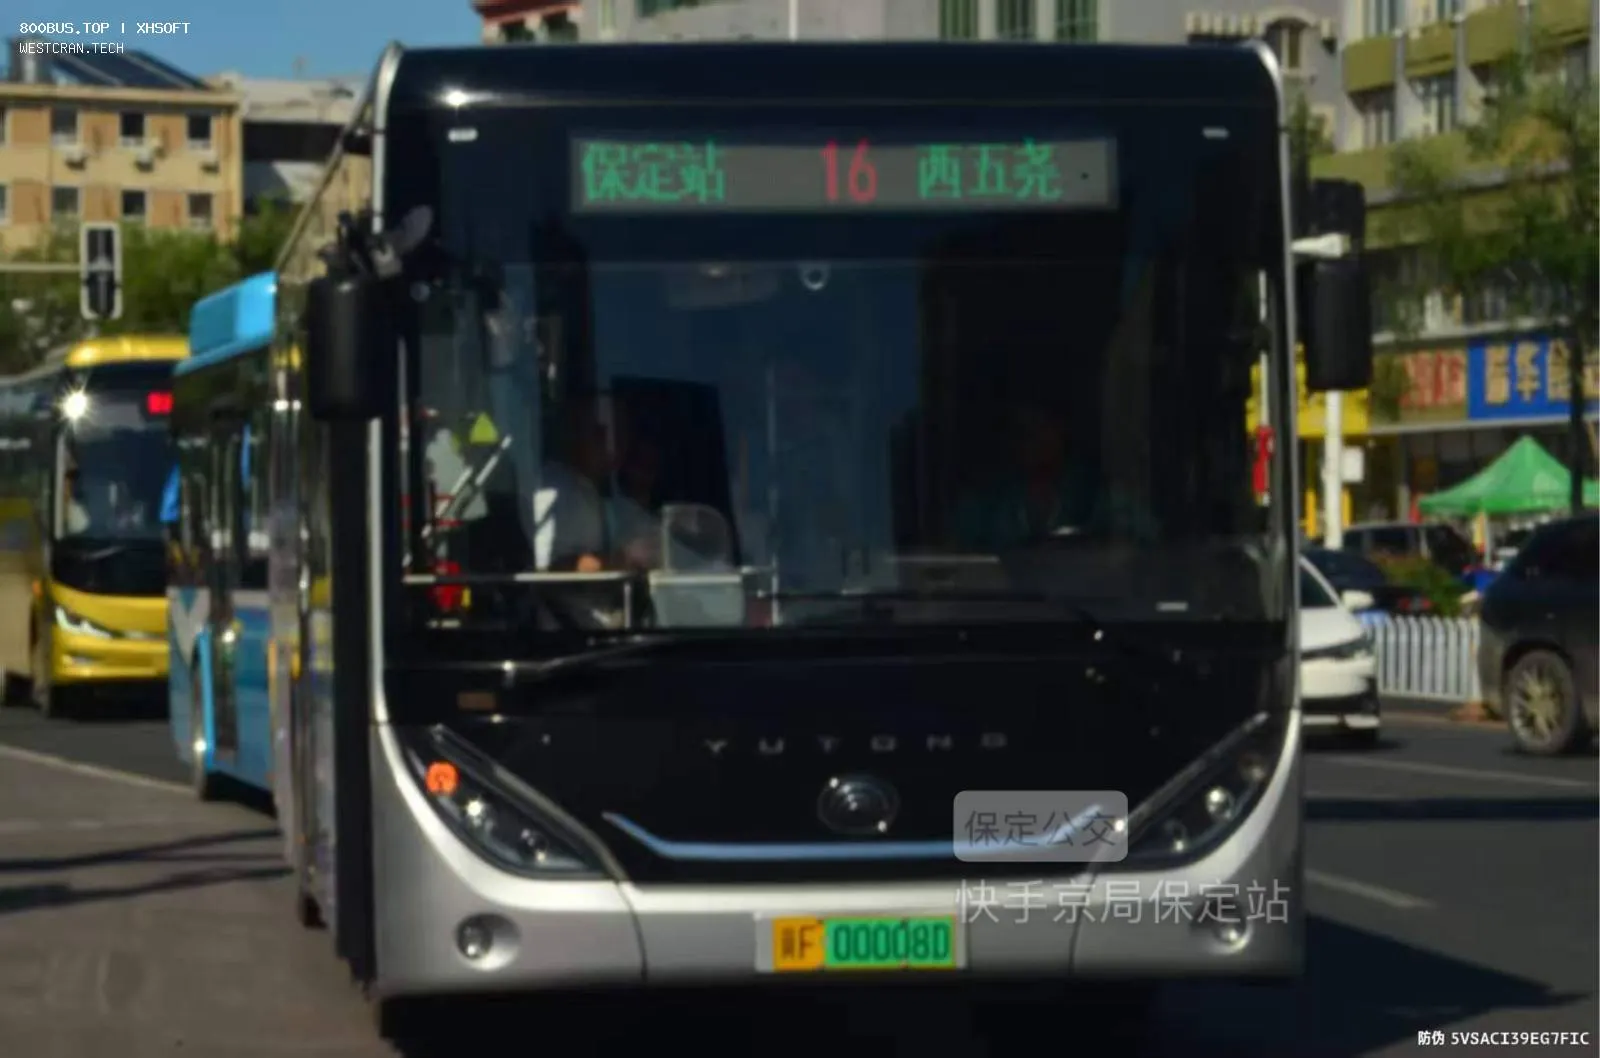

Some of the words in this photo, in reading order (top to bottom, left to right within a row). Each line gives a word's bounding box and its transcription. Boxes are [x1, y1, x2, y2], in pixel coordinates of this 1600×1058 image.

[581, 139, 726, 201] 保定站
[820, 139, 878, 202] 16
[917, 137, 1062, 200] 西五尧
